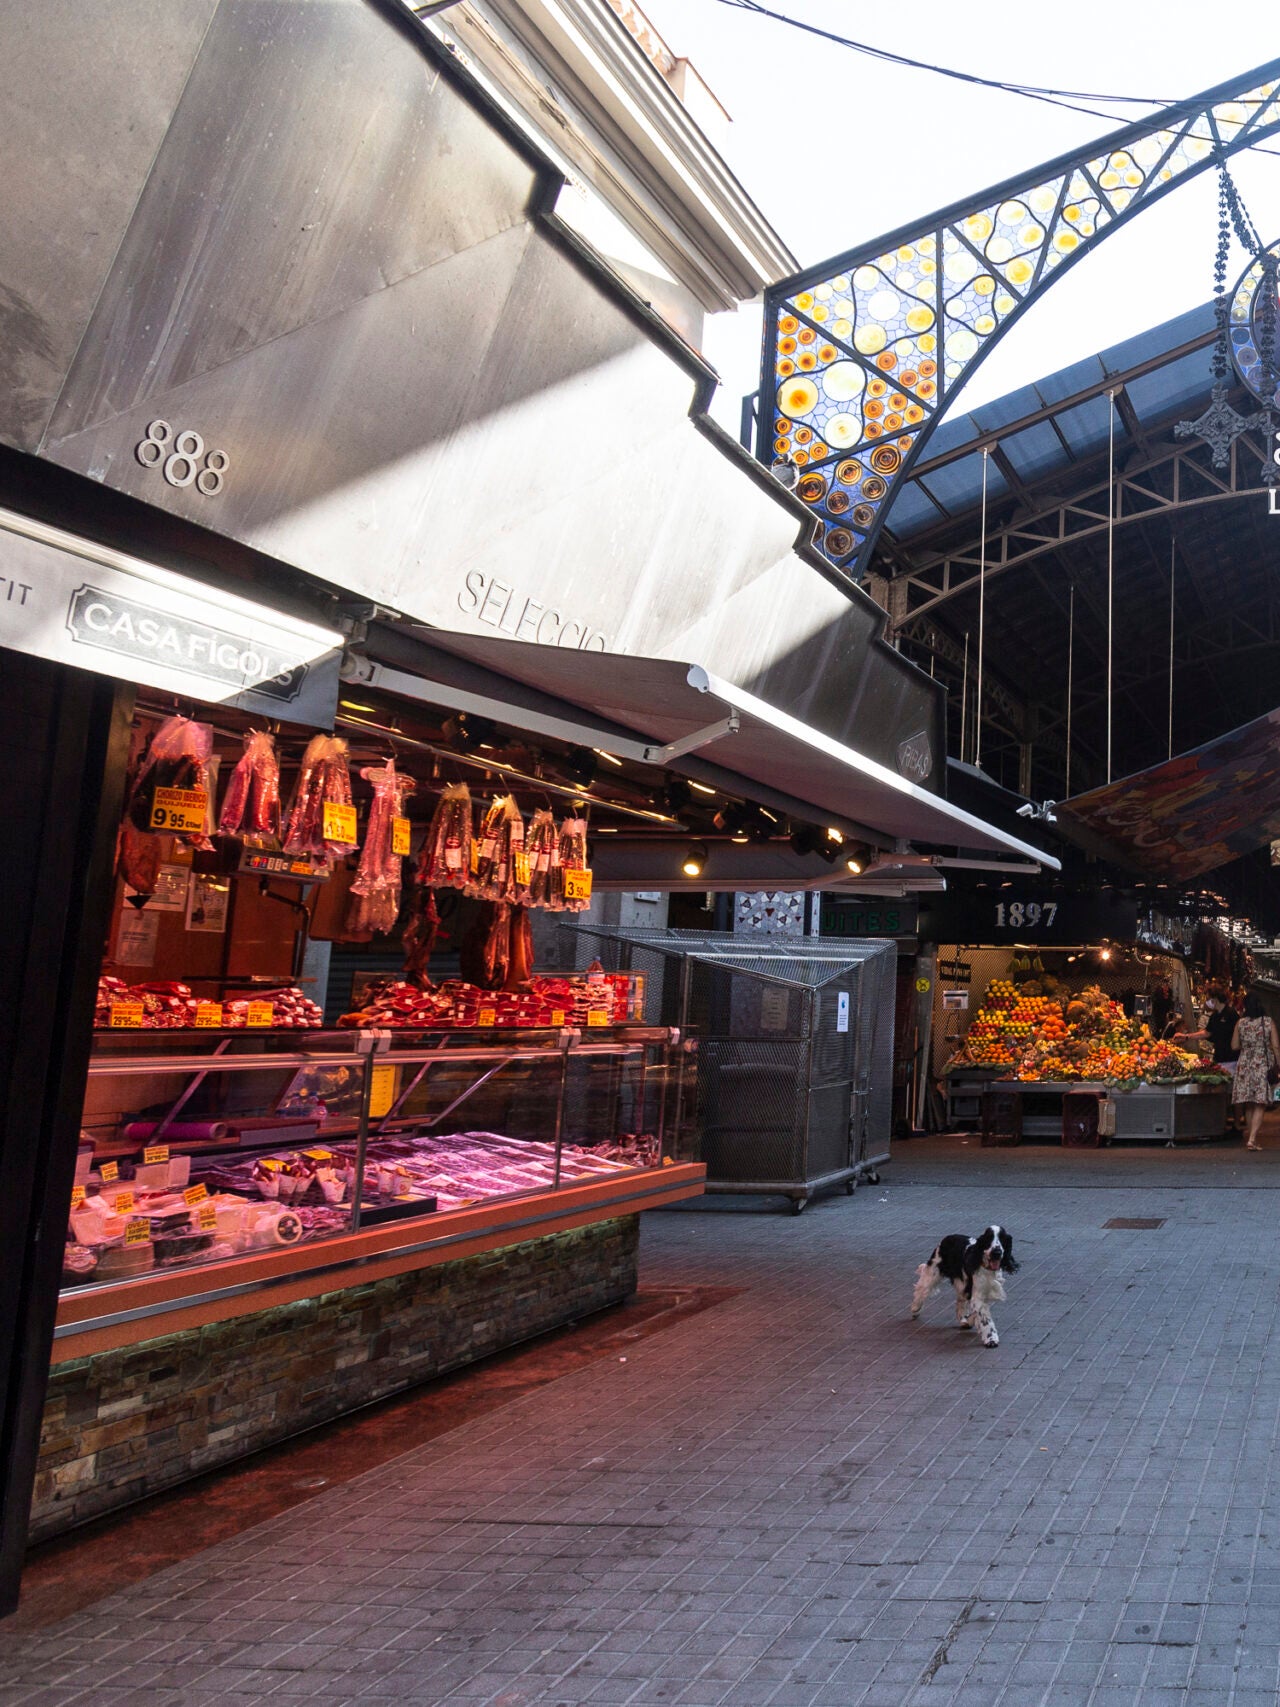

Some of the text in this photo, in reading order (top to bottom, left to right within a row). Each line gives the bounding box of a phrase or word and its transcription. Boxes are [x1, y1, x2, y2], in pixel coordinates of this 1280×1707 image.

[134, 420, 230, 496] 888
[84, 603, 182, 655] CASA
[457, 568, 626, 654] SELECCIO
[994, 902, 1058, 928] 1897
